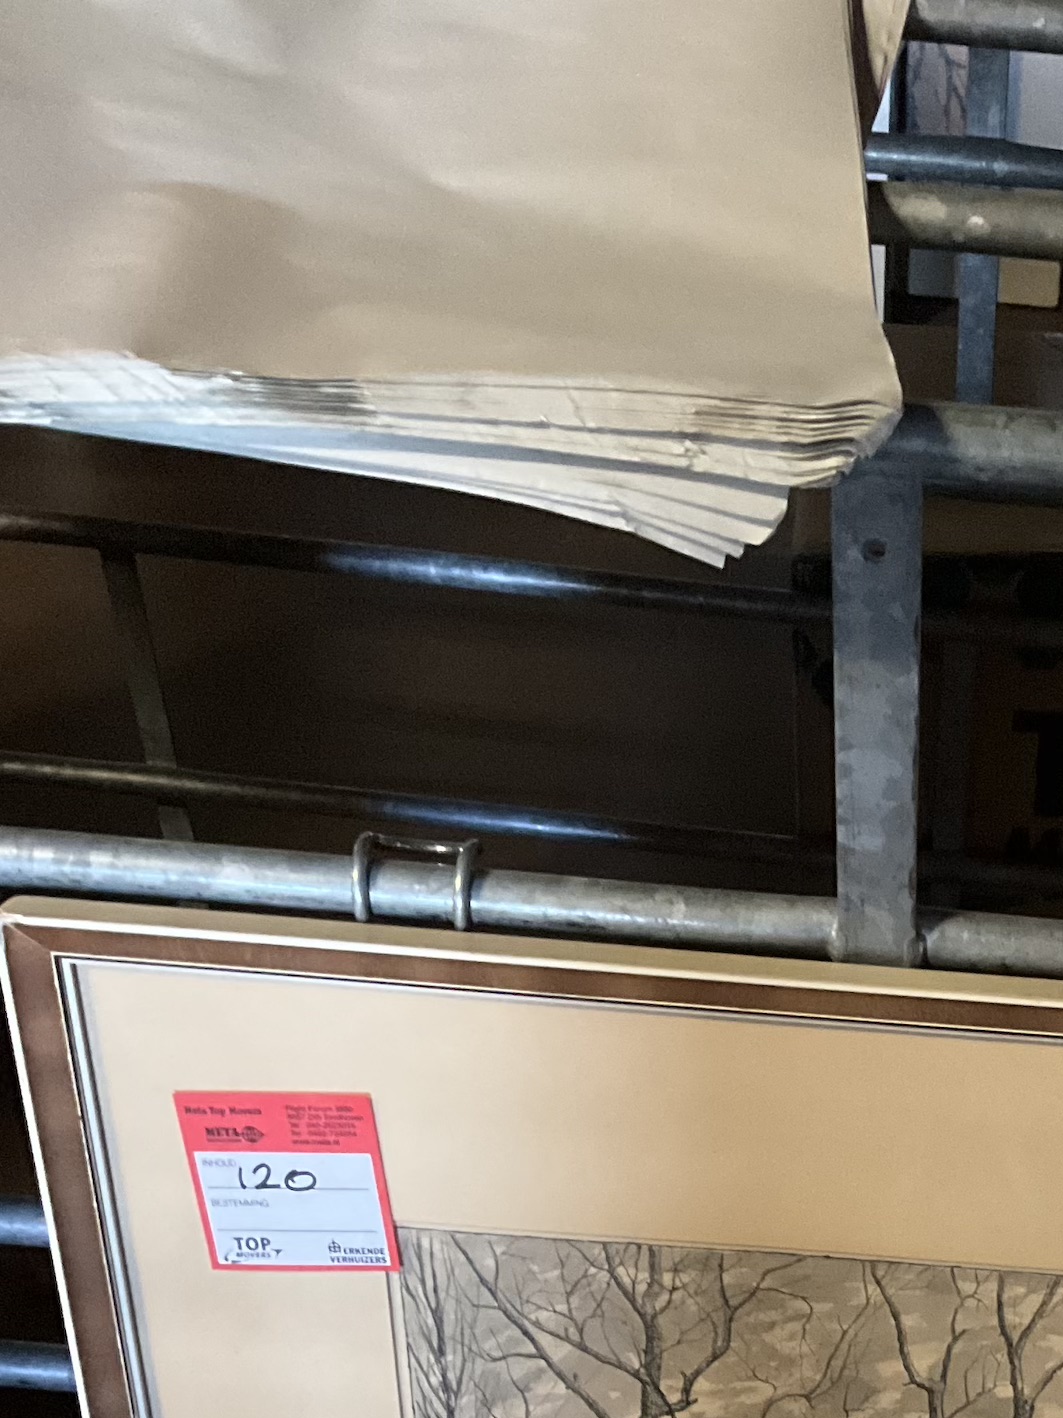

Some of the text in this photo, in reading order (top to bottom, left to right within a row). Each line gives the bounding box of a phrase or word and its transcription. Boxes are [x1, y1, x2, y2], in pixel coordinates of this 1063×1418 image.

[205, 1127, 242, 1138] META
[202, 1158, 236, 1167] INHOUD
[238, 1163, 317, 1192] 120
[211, 1199, 270, 1208] BESTEMMING
[233, 1237, 271, 1251] TOP
[236, 1251, 271, 1259] MOVERS
[343, 1247, 385, 1256] ERKENDE
[330, 1255, 387, 1264] VERHUIZERS
